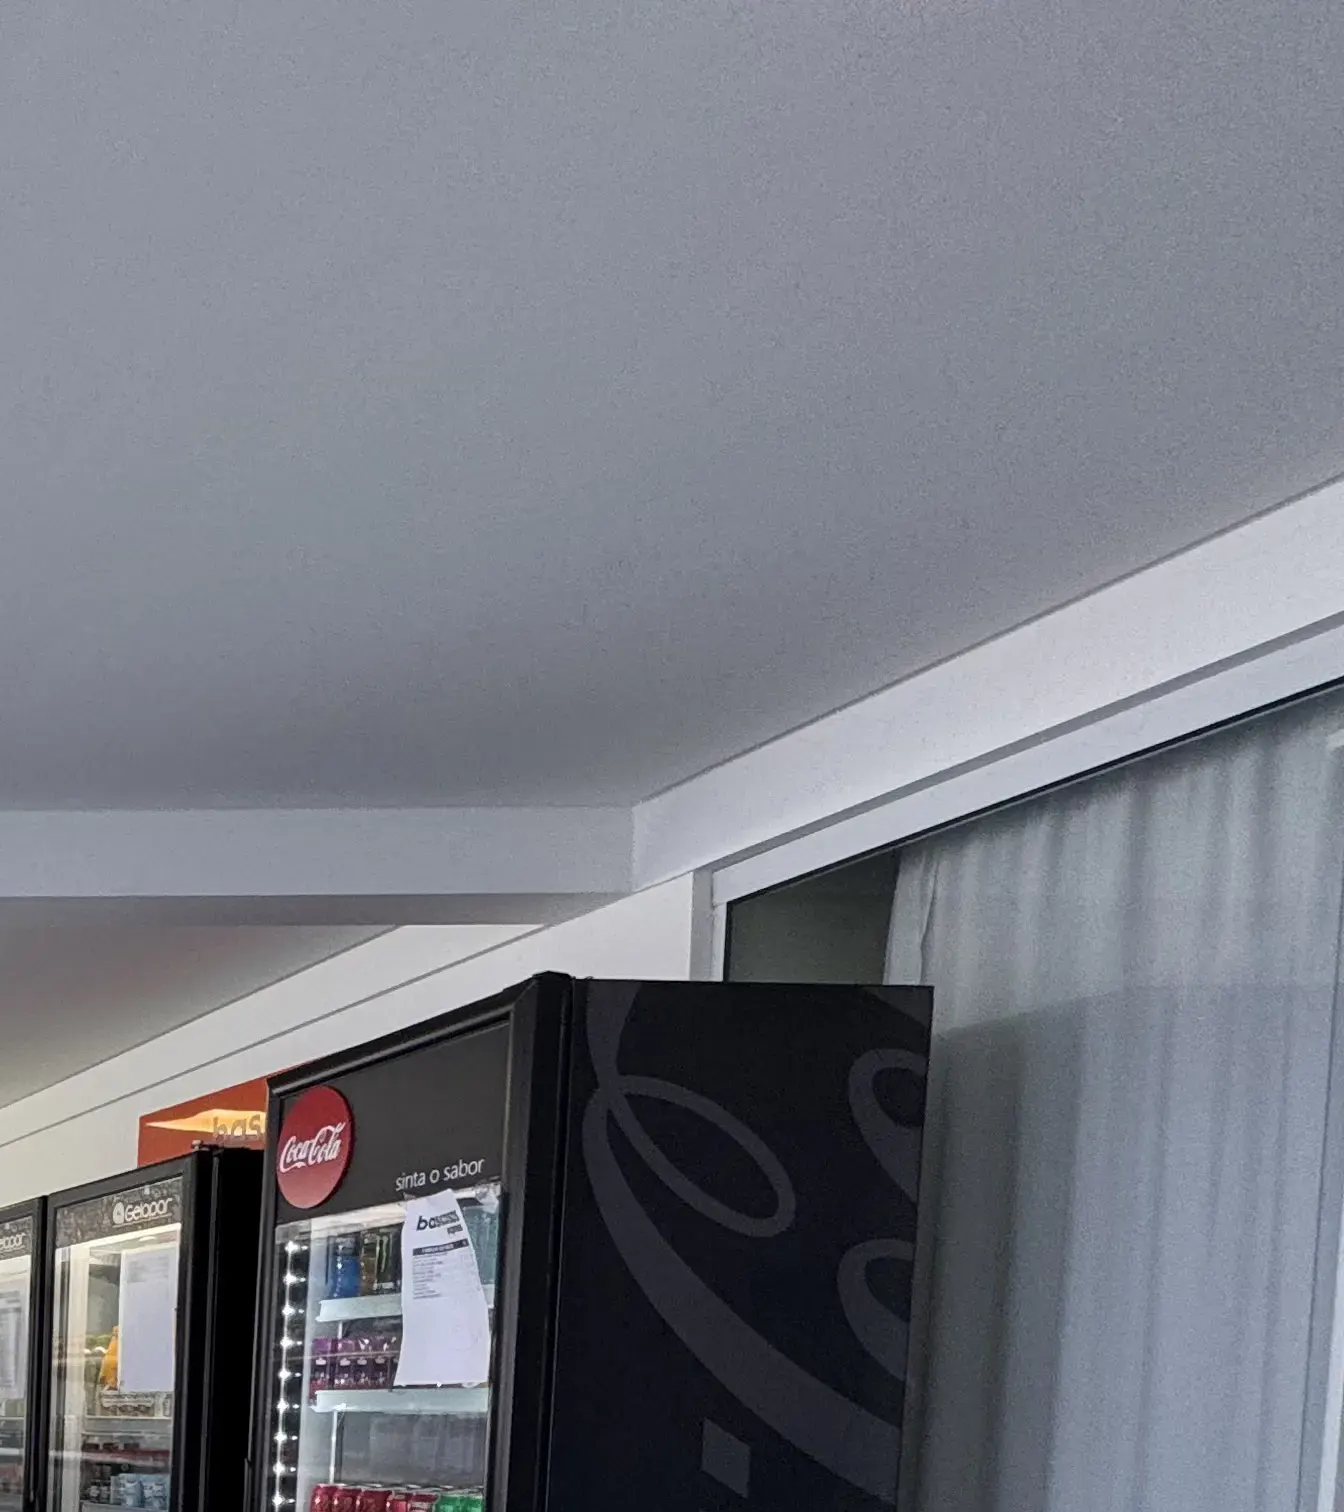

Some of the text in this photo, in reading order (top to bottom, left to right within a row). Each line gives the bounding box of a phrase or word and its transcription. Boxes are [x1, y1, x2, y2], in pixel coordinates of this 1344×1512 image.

[279, 1121, 346, 1173] Coca-Cola
[395, 1157, 485, 1192] sinta o sabor
